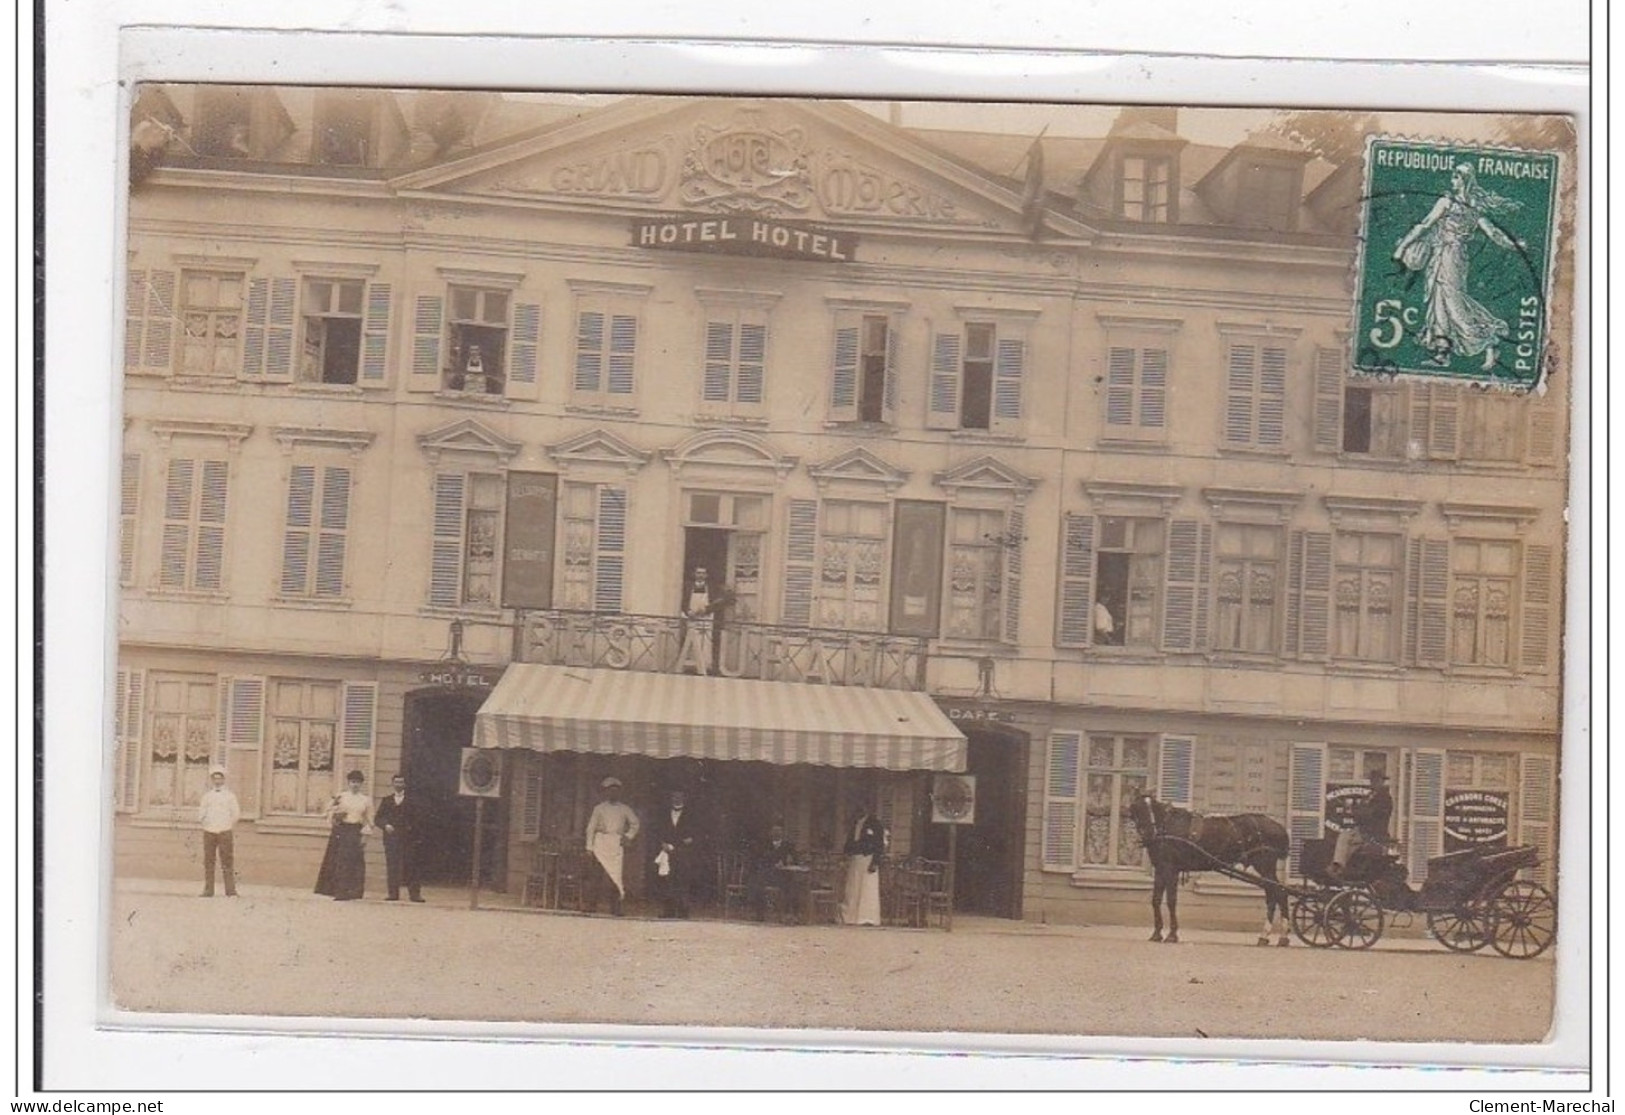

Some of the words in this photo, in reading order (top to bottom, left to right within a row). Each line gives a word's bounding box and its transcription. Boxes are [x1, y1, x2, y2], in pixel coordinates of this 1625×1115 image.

[550, 150, 665, 194] GRAND
[1377, 149, 1455, 171] REPUBLIQUE
[1478, 157, 1550, 180] FRANÇAISE
[640, 220, 737, 245] HOTEL
[752, 222, 846, 260] HOTEL
[1515, 296, 1538, 371] POSTES
[521, 617, 920, 689] RESTAURANT
[430, 673, 490, 686] HOTEL
